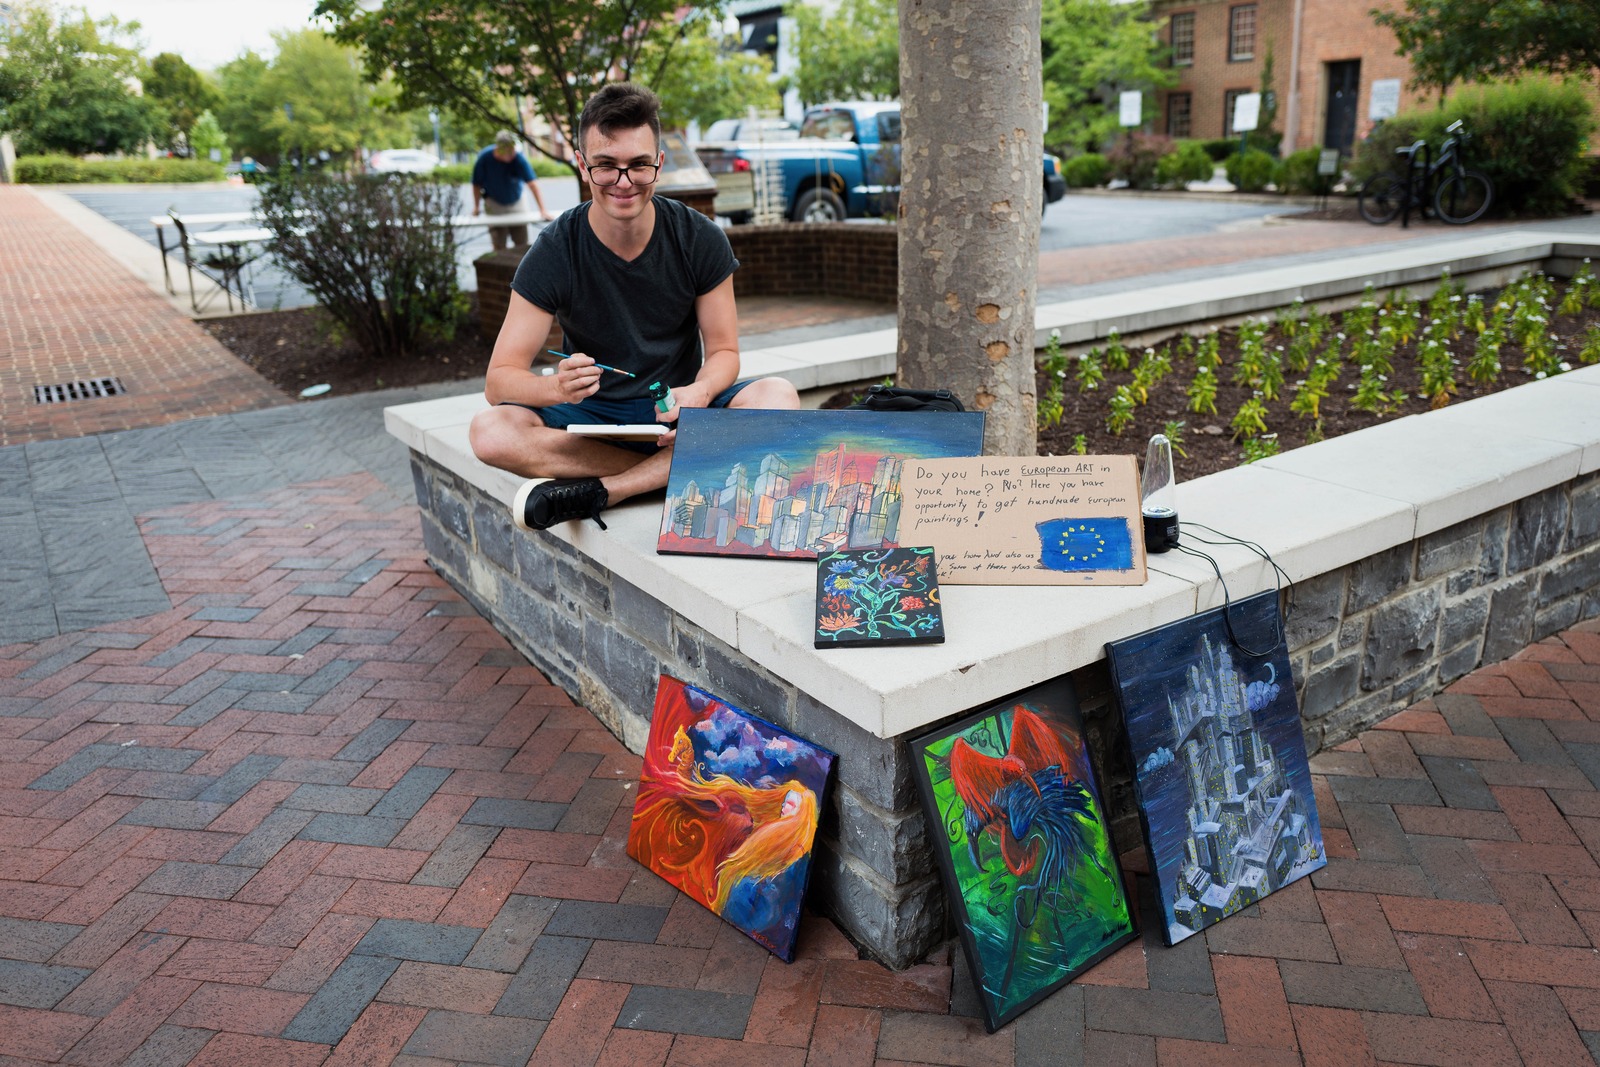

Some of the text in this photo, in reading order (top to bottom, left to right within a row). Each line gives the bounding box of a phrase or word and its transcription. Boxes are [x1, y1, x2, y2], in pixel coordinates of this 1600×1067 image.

[916, 466, 933, 479] Do
[941, 471, 967, 486] you
[981, 463, 1010, 477] have
[1075, 463, 1094, 473] ART
[1030, 478, 1051, 489] Here
[1060, 481, 1076, 492] you
[1081, 479, 1104, 487] have
[915, 498, 967, 515] opportunity
[977, 499, 988, 508] to
[994, 496, 1017, 513] get
